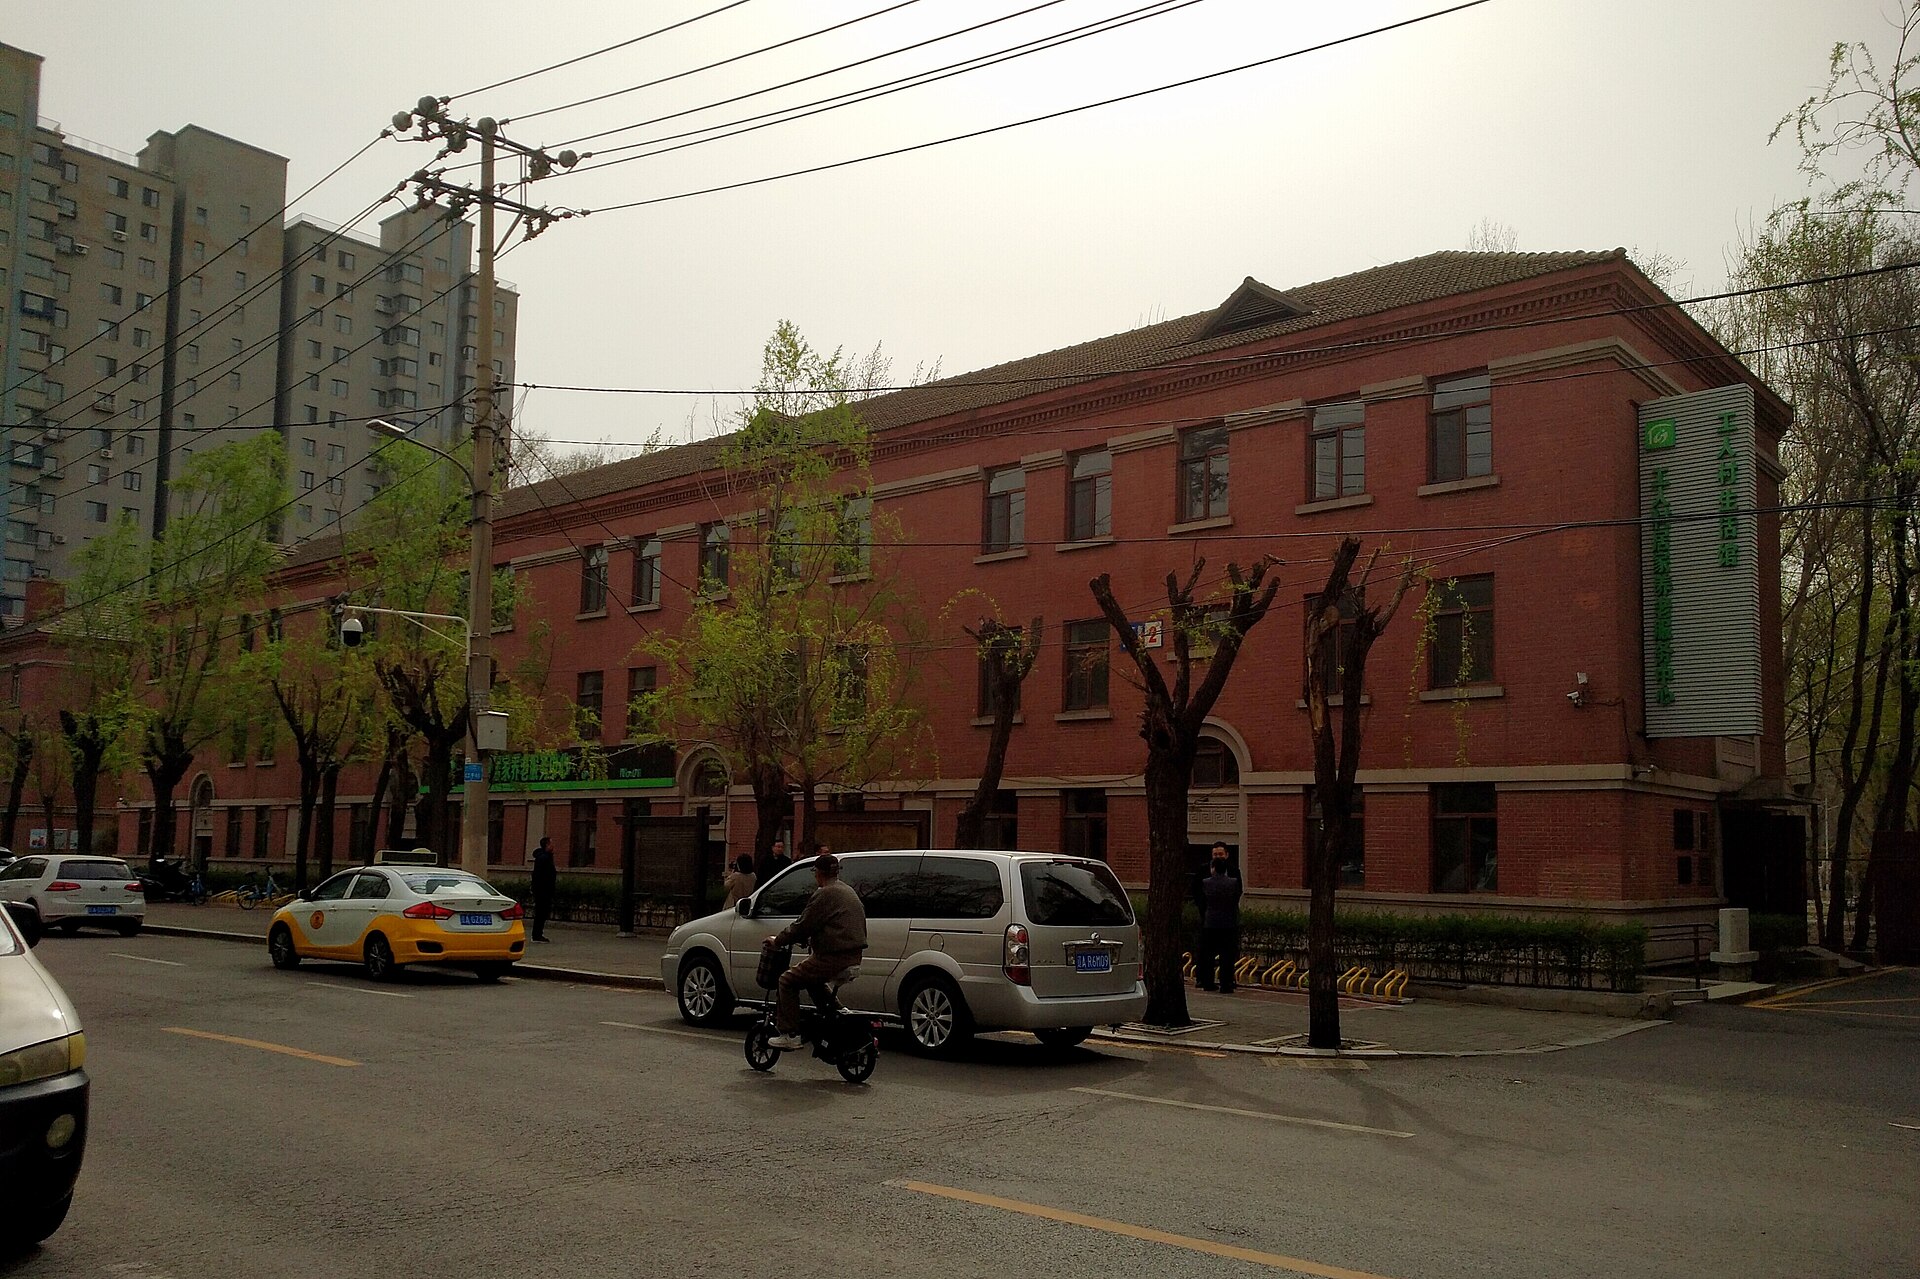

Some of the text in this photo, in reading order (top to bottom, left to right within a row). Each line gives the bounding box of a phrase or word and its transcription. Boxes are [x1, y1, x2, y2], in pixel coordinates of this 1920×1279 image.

[1652, 469, 1675, 704] 工人村居家养老服务中心
[1716, 411, 1739, 567] 工人村生活馆
